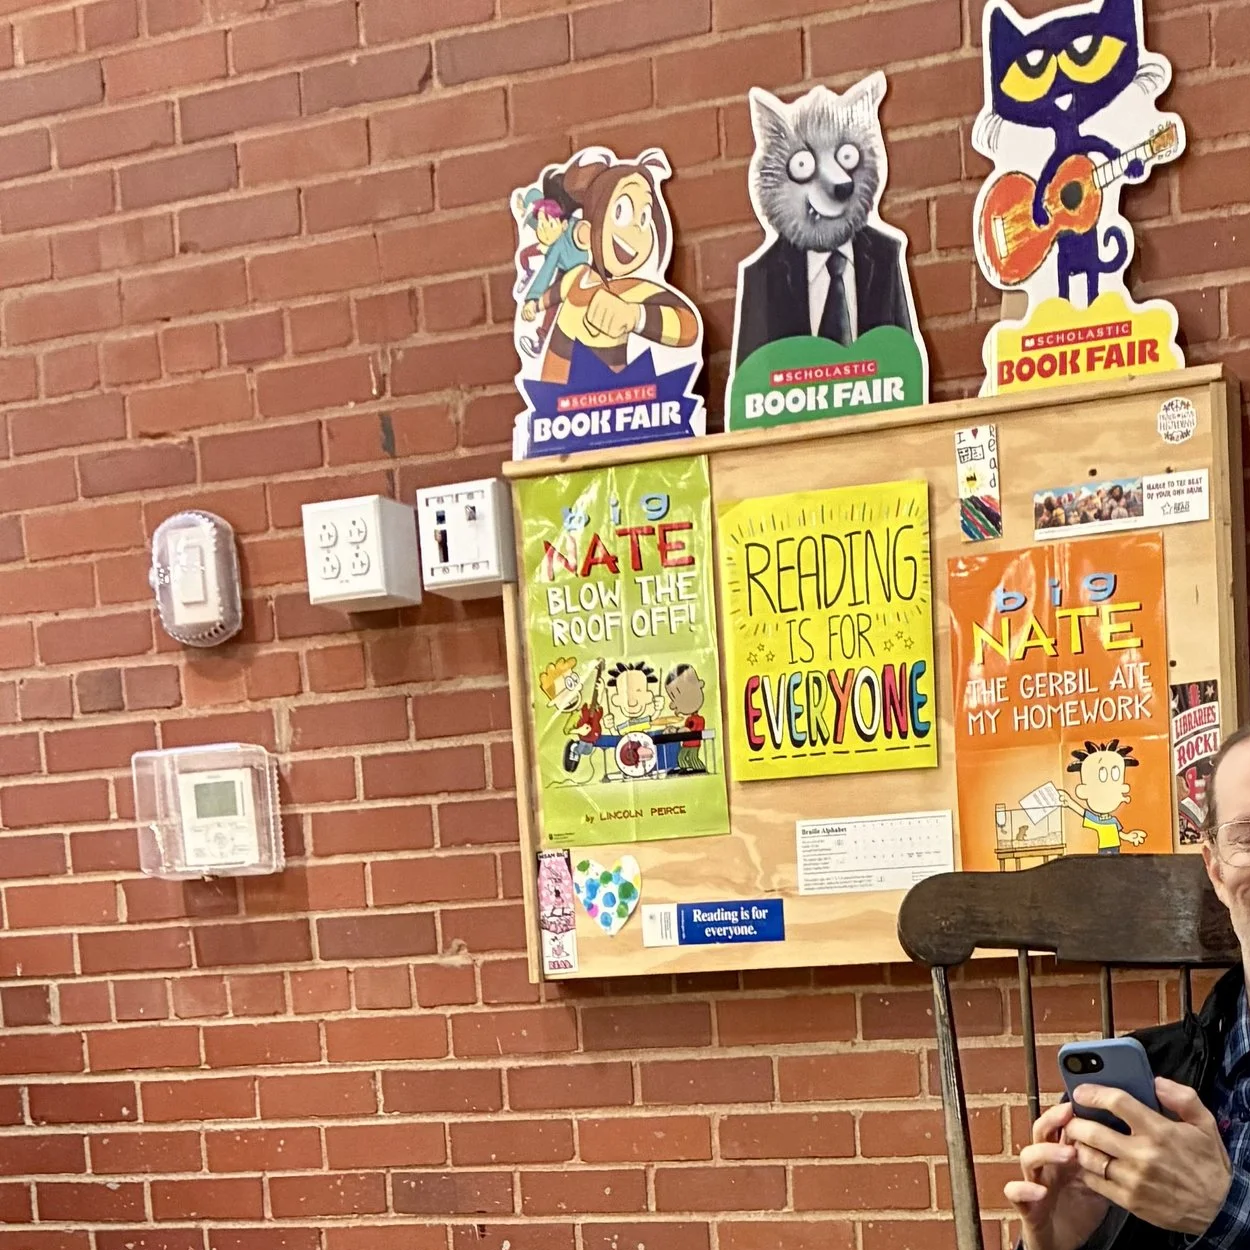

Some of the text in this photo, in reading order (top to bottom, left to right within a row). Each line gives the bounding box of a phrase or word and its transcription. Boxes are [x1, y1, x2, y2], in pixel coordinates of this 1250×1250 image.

[1037, 323, 1129, 346] SCHOLASTIC
[786, 362, 876, 382] SCHOLASTIC
[998, 338, 1159, 386] BOOK FAIR
[572, 387, 655, 407] SCHOLASTIC
[745, 376, 904, 419] BOOK FAIR
[533, 401, 681, 443] BOOK FAIR
[561, 492, 671, 531] big
[1156, 491, 1172, 499] YOUR
[543, 521, 696, 581] NATE
[744, 525, 917, 616] READING
[547, 571, 697, 616] BLOW THE
[994, 572, 1117, 613] big
[552, 604, 697, 647] ROOF OFF!
[786, 613, 876, 664] IS FOR
[972, 601, 1142, 666] NATE
[968, 661, 1153, 705] THE GERBIL ATE
[744, 660, 931, 751] EVERYONE
[968, 693, 1153, 736] MY HOMEWORK
[1174, 705, 1216, 740] LIBRARIES
[585, 805, 687, 824] by LINCOLN PEIRCE
[821, 826, 847, 836] Alphabet
[692, 906, 768, 923] Reading is for
[704, 924, 758, 939] everyone.
